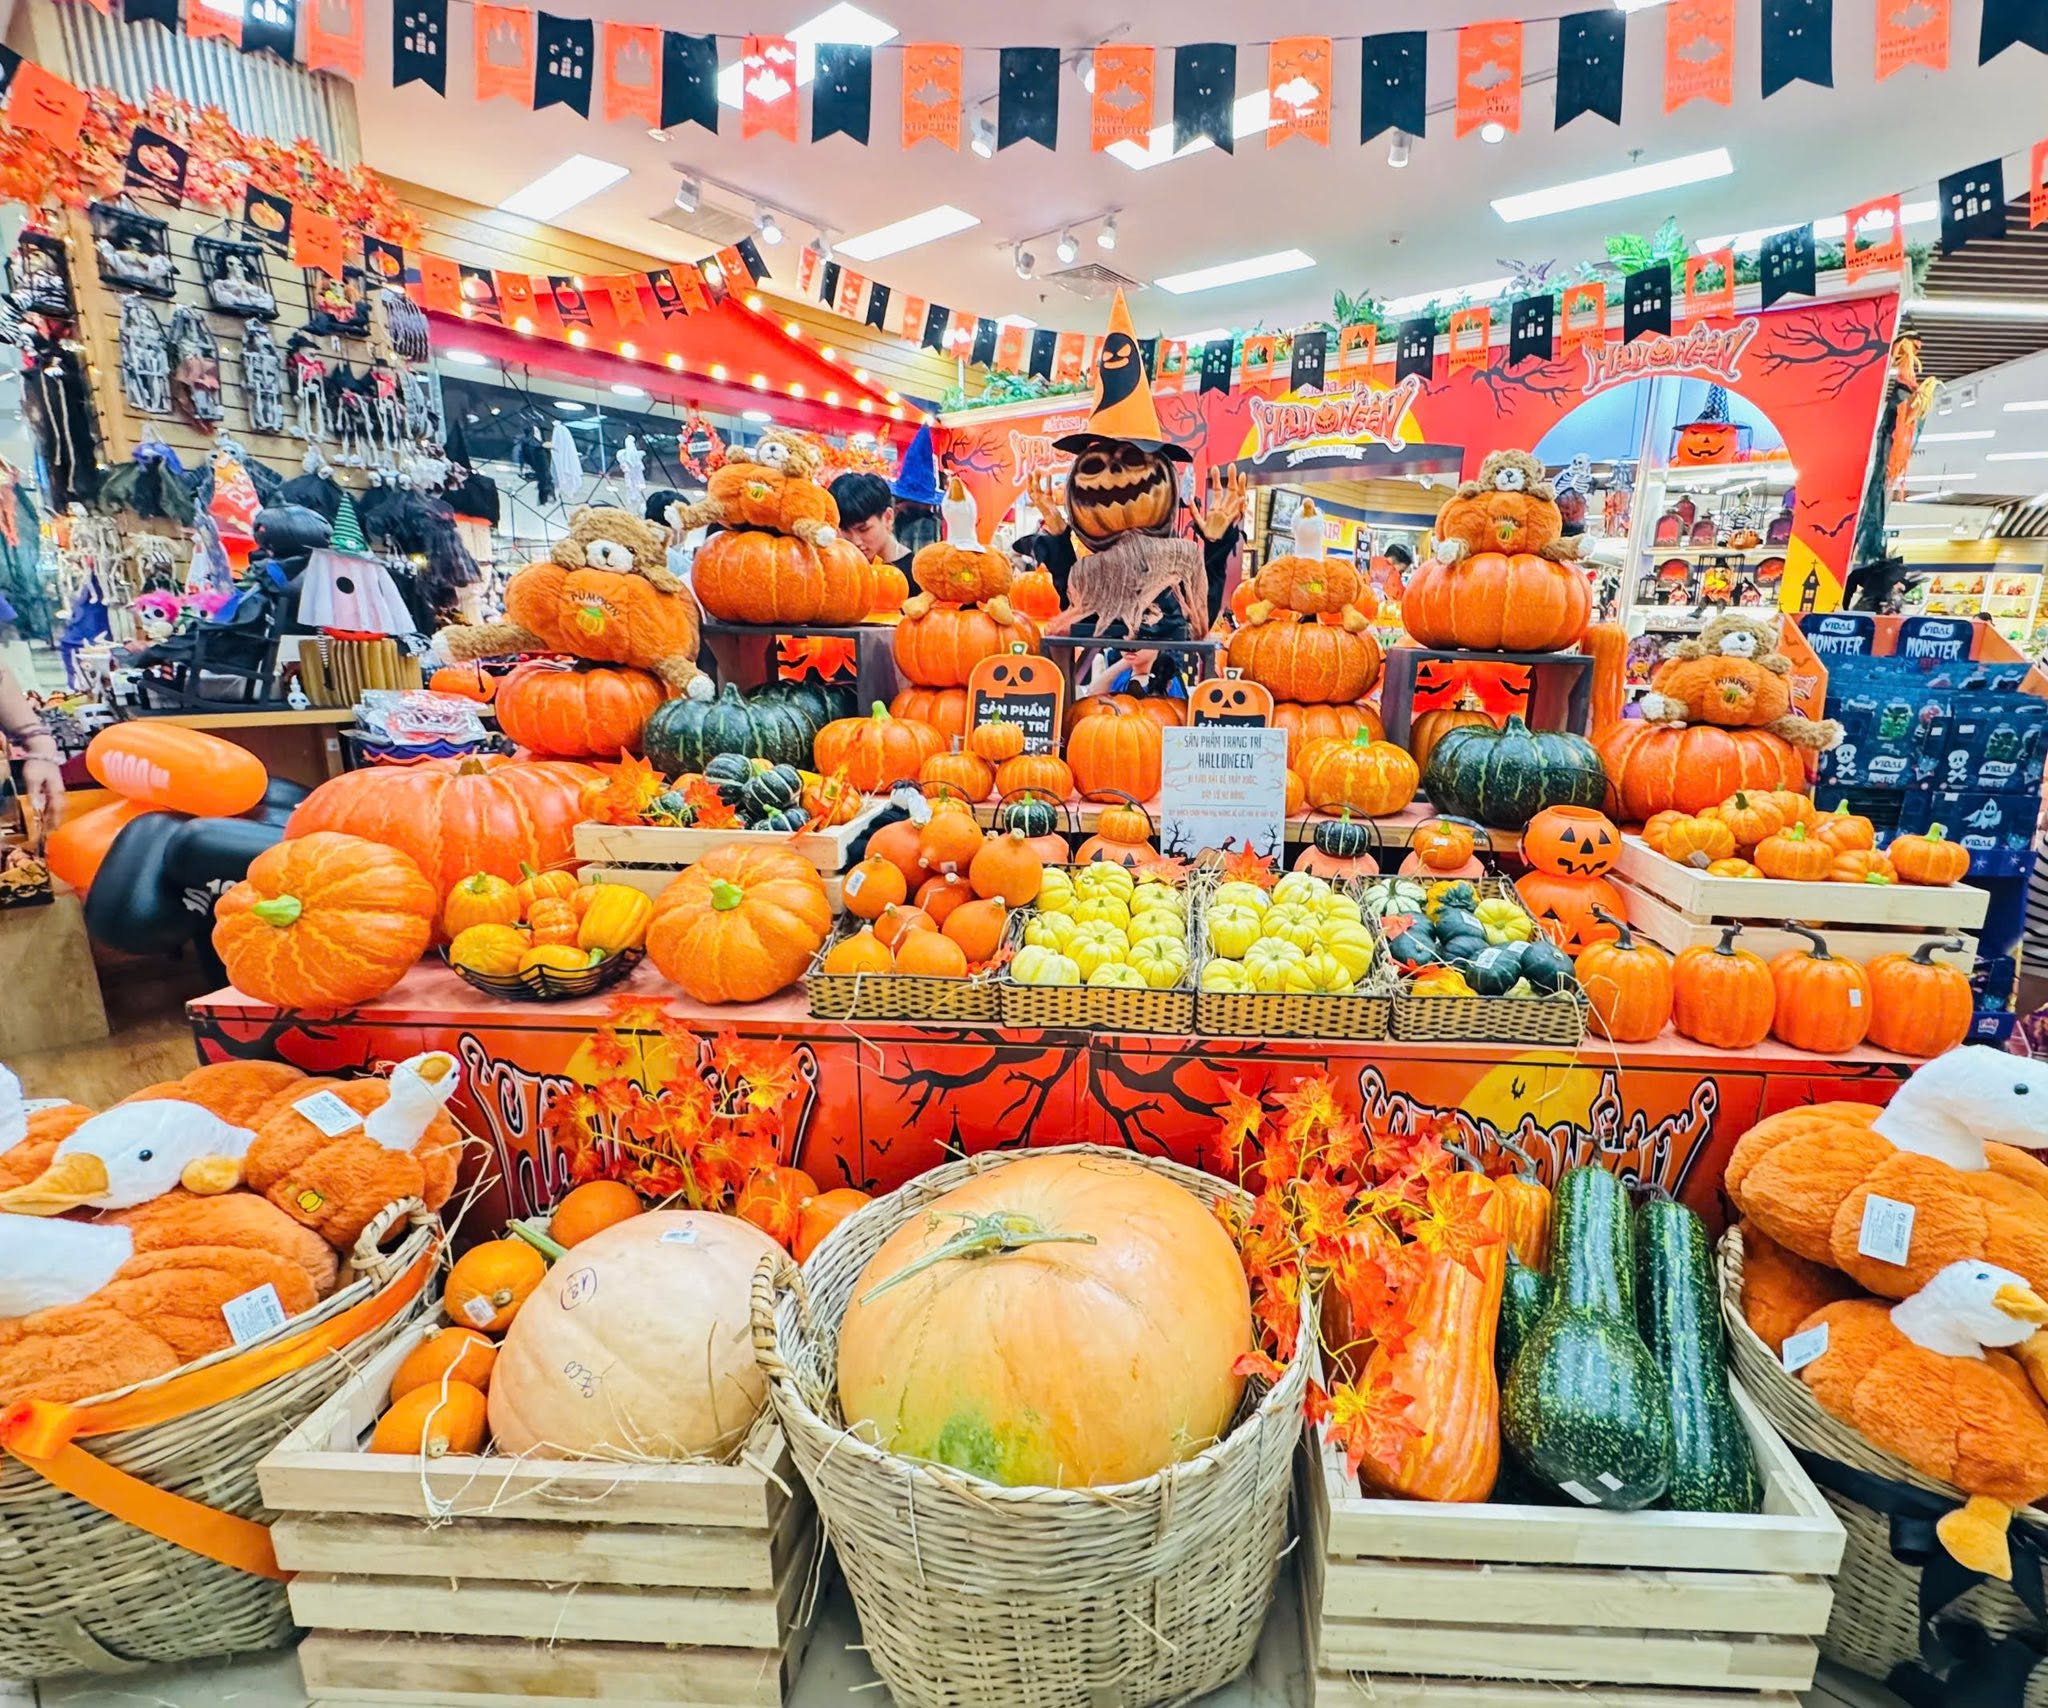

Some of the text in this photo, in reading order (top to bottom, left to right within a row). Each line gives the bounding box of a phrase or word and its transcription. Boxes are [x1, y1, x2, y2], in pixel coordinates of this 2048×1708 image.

[1881, 40, 1947, 59] HALLOWEEN
[1251, 375, 1419, 463] HALLOWEEN
[1824, 621, 1852, 631] VIDAL
[1924, 625, 1951, 636] VIDAL
[1807, 633, 1864, 656] MONSTER
[1905, 637, 1963, 661] MONSTER
[1009, 702, 1051, 717] PHẨM
[1027, 719, 1050, 733] TRÍ
[1184, 731, 1199, 748] SẢN
[1223, 735, 1247, 748] TRANG
[1250, 733, 1262, 749] TRÍ
[1198, 752, 1254, 769] HALLOWEEN
[1874, 760, 1902, 769] VIDAL
[1985, 765, 2012, 774] VIDAL
[1964, 838, 1992, 848] VIDAL
